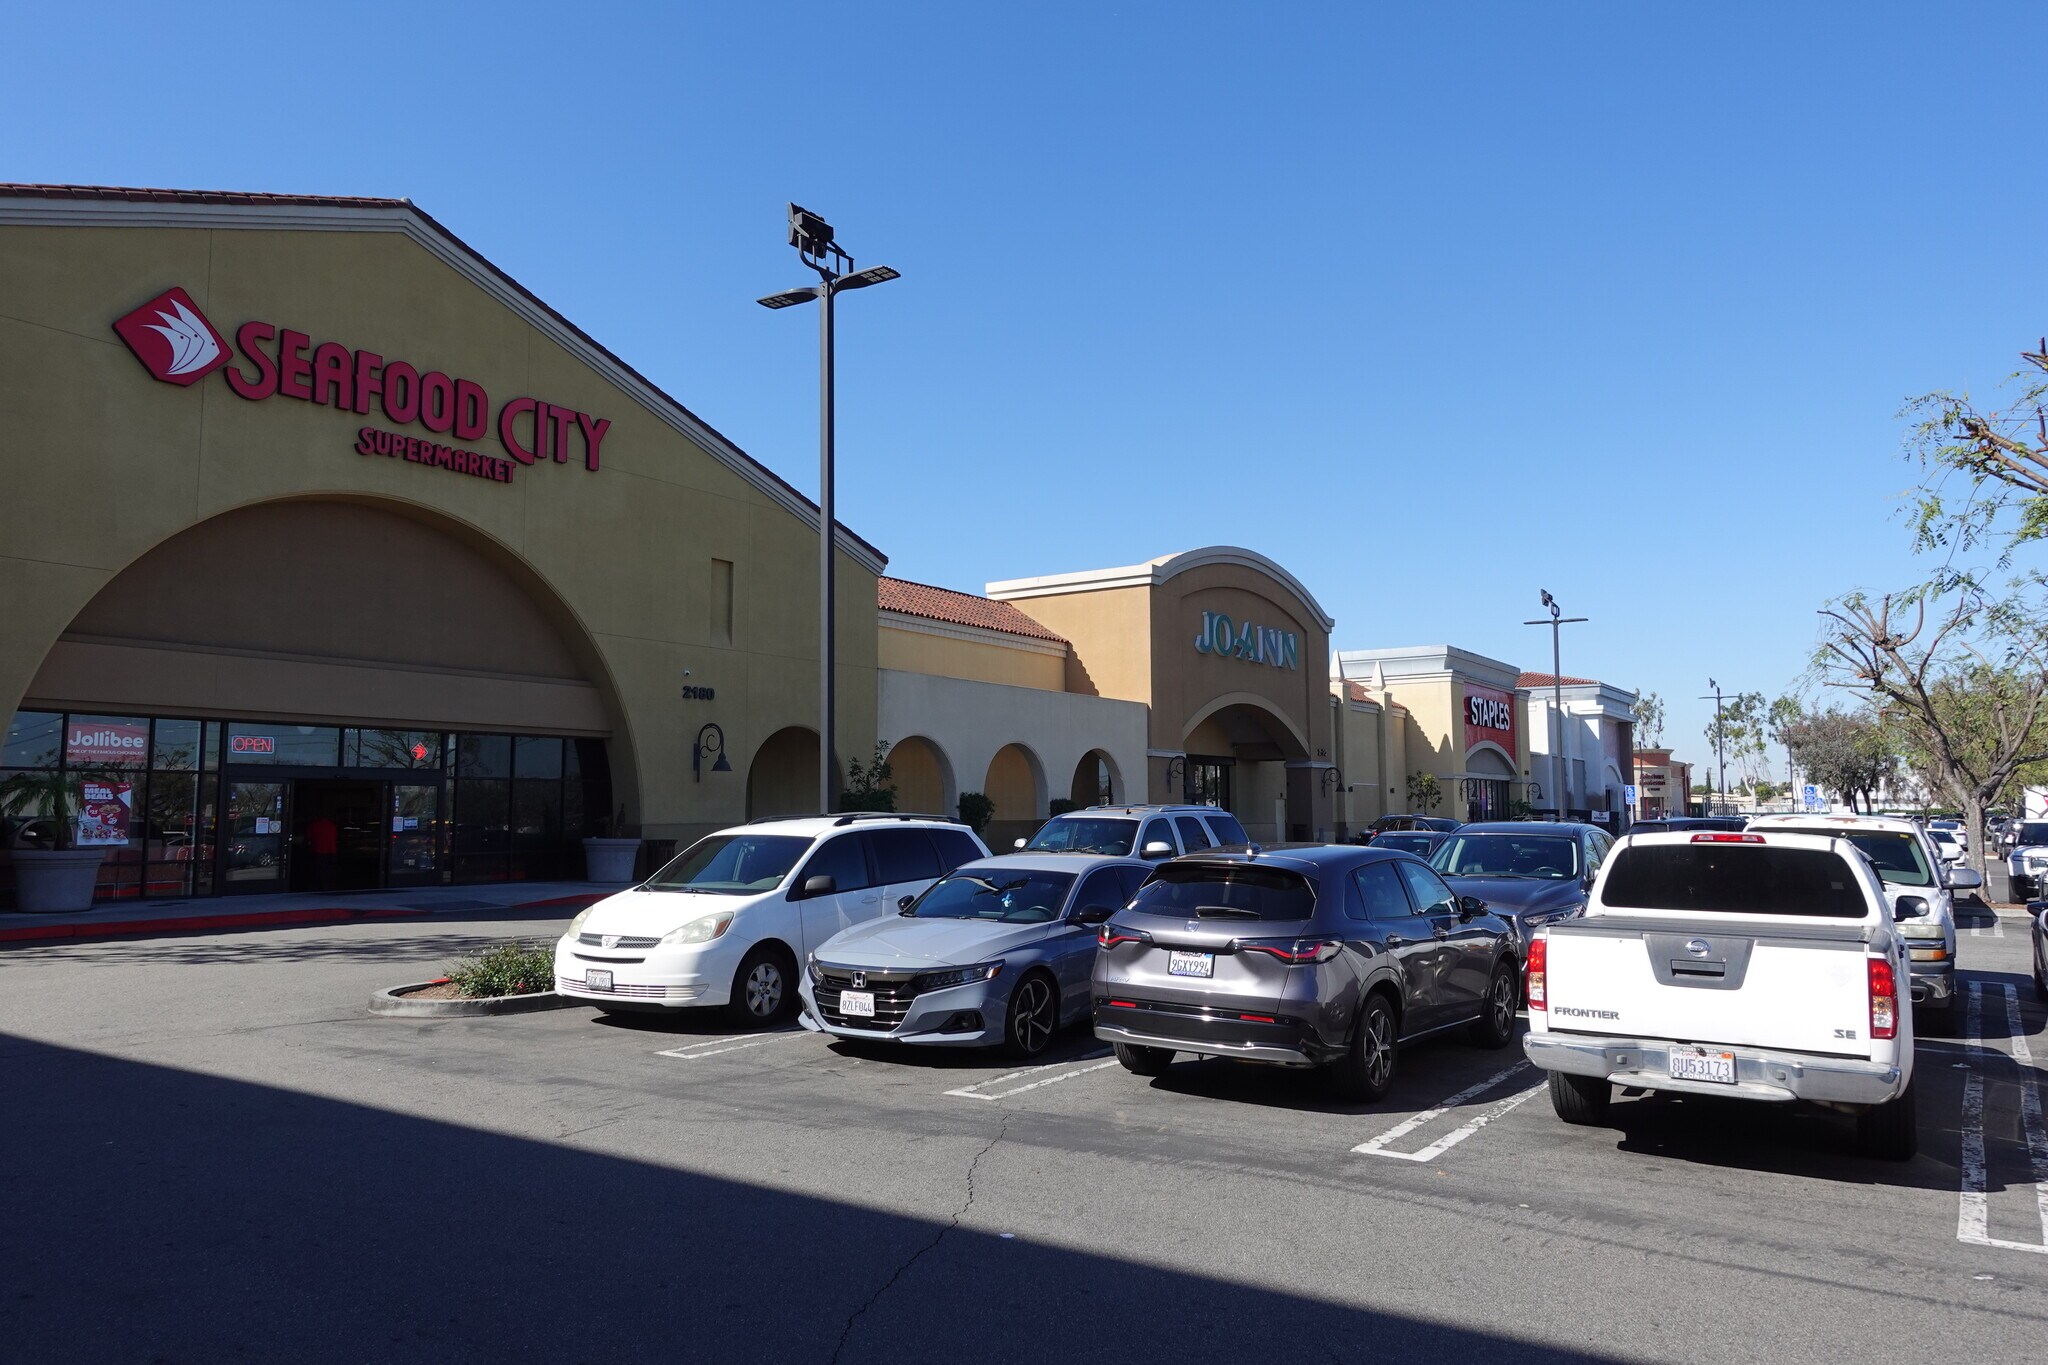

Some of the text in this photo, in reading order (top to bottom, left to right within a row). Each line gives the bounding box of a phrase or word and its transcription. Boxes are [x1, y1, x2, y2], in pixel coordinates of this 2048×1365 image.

[224, 321, 611, 472] SEAFOOD CITY
[354, 426, 517, 484] SUPERMARKET
[682, 685, 715, 700] 2180
[1471, 696, 1510, 731] STAPLES
[69, 730, 144, 748] Jollibee
[233, 737, 271, 751] OPEN
[1171, 958, 1209, 973] 9GXY994
[842, 999, 872, 1012] 8ZLF044
[1554, 1006, 1620, 1020] FRONTIER
[1833, 1029, 1856, 1040] SE
[1672, 1057, 1730, 1077] 8U53173
